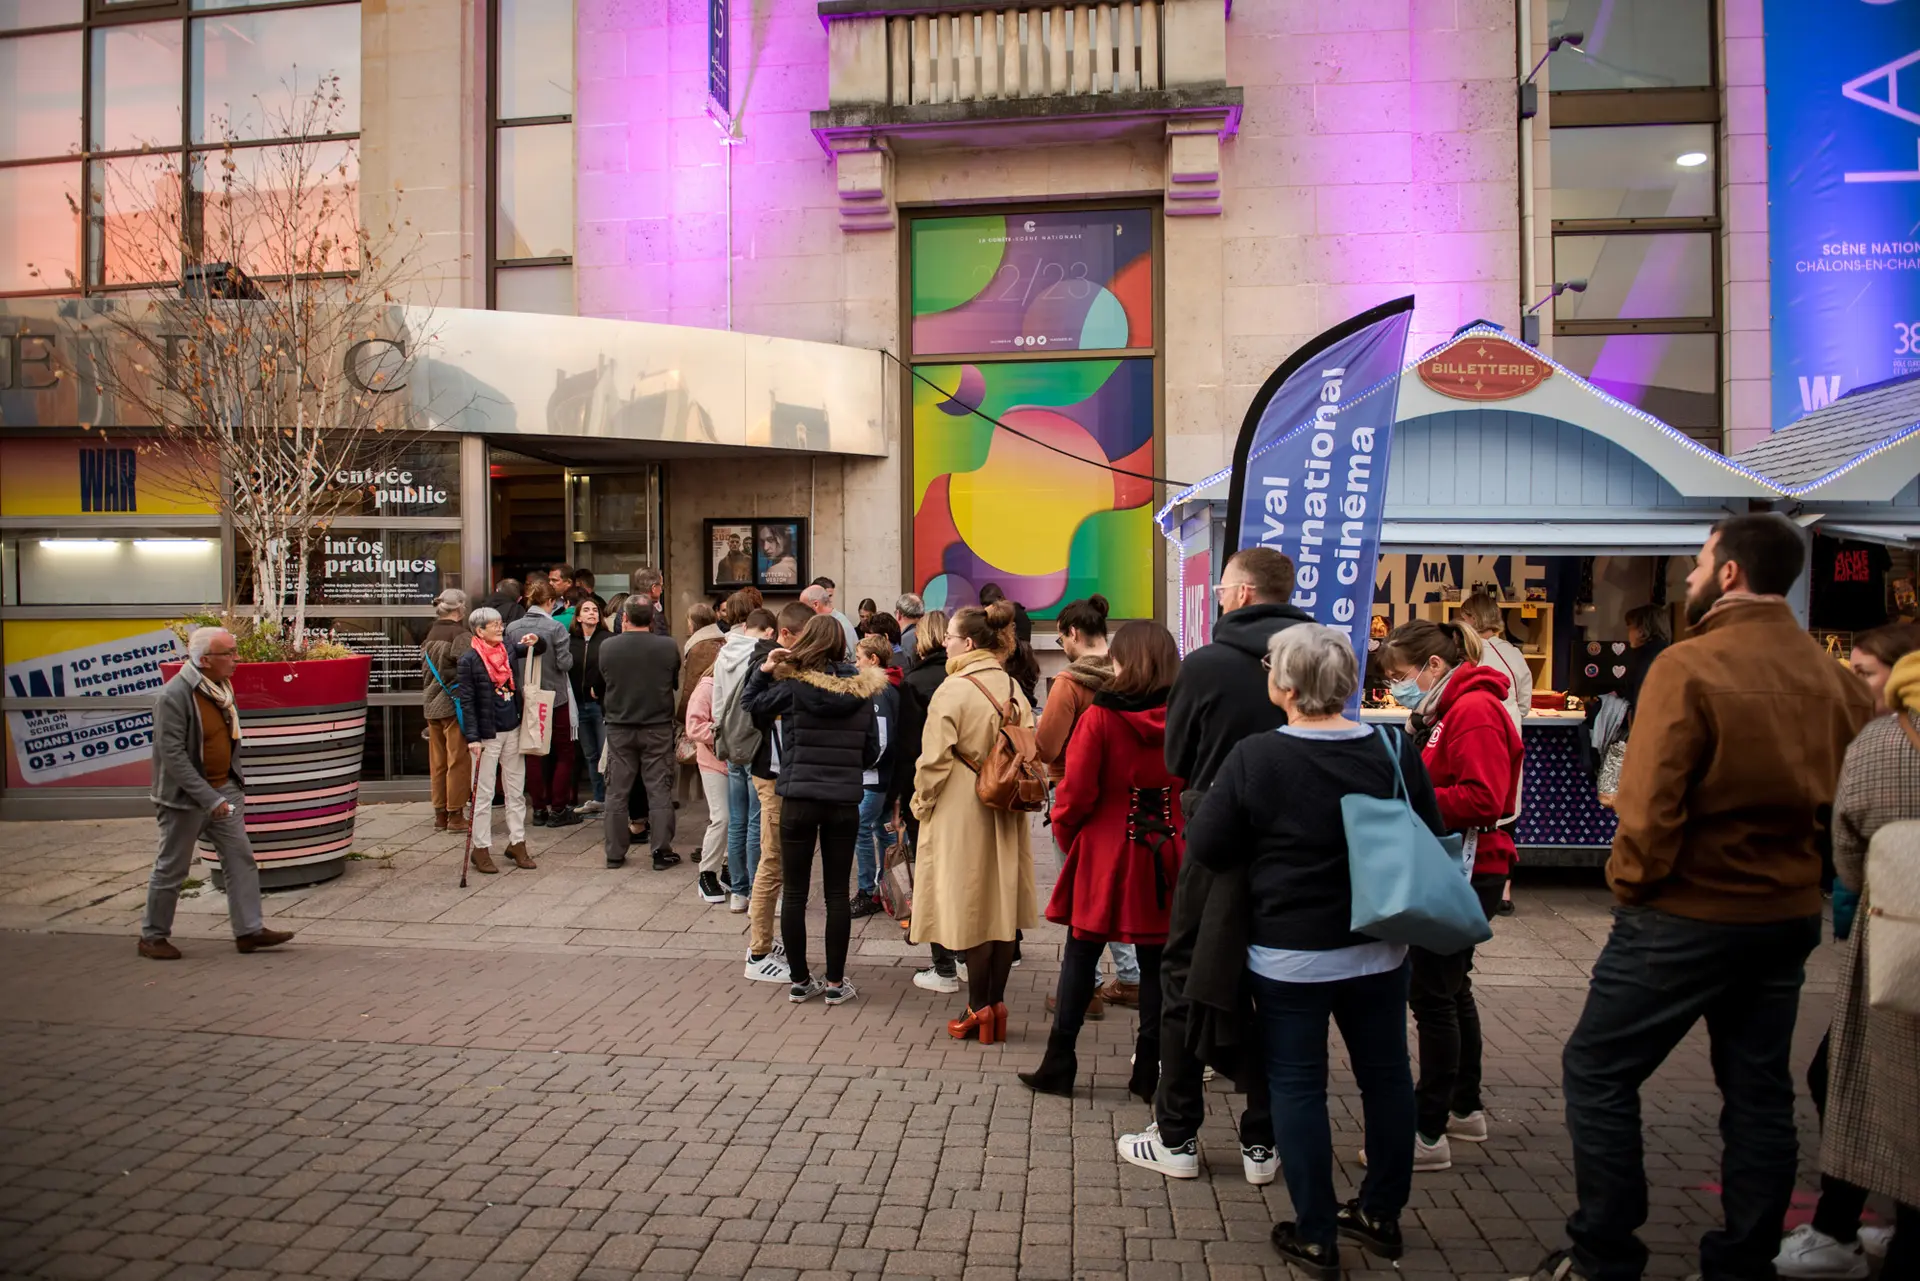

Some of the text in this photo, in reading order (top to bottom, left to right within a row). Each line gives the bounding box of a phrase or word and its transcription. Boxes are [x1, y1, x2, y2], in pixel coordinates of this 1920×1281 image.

[1823, 242, 1867, 256] SCÈNE
[1796, 258, 1920, 273] CHÂLONS-EN-CHA
[1432, 362, 1535, 376] BILLETTERIE
[79, 448, 137, 512] WAR
[336, 467, 413, 484] entrée
[374, 485, 447, 509] public
[1291, 367, 1346, 618] ternational
[1256, 476, 1290, 556] ival
[1334, 426, 1376, 586] cinéma
[324, 535, 384, 555] infos
[324, 554, 436, 579] pratiques
[1422, 562, 1447, 582] W
[101, 639, 176, 667] Festival
[74, 654, 189, 688] Internati
[107, 676, 164, 697] ciném
[27, 713, 67, 728] WAR ON
[30, 722, 69, 736] SCREEN
[28, 714, 153, 752] 10ANS 10ANS 10AN
[29, 752, 56, 770] 03
[81, 740, 109, 759] 09
